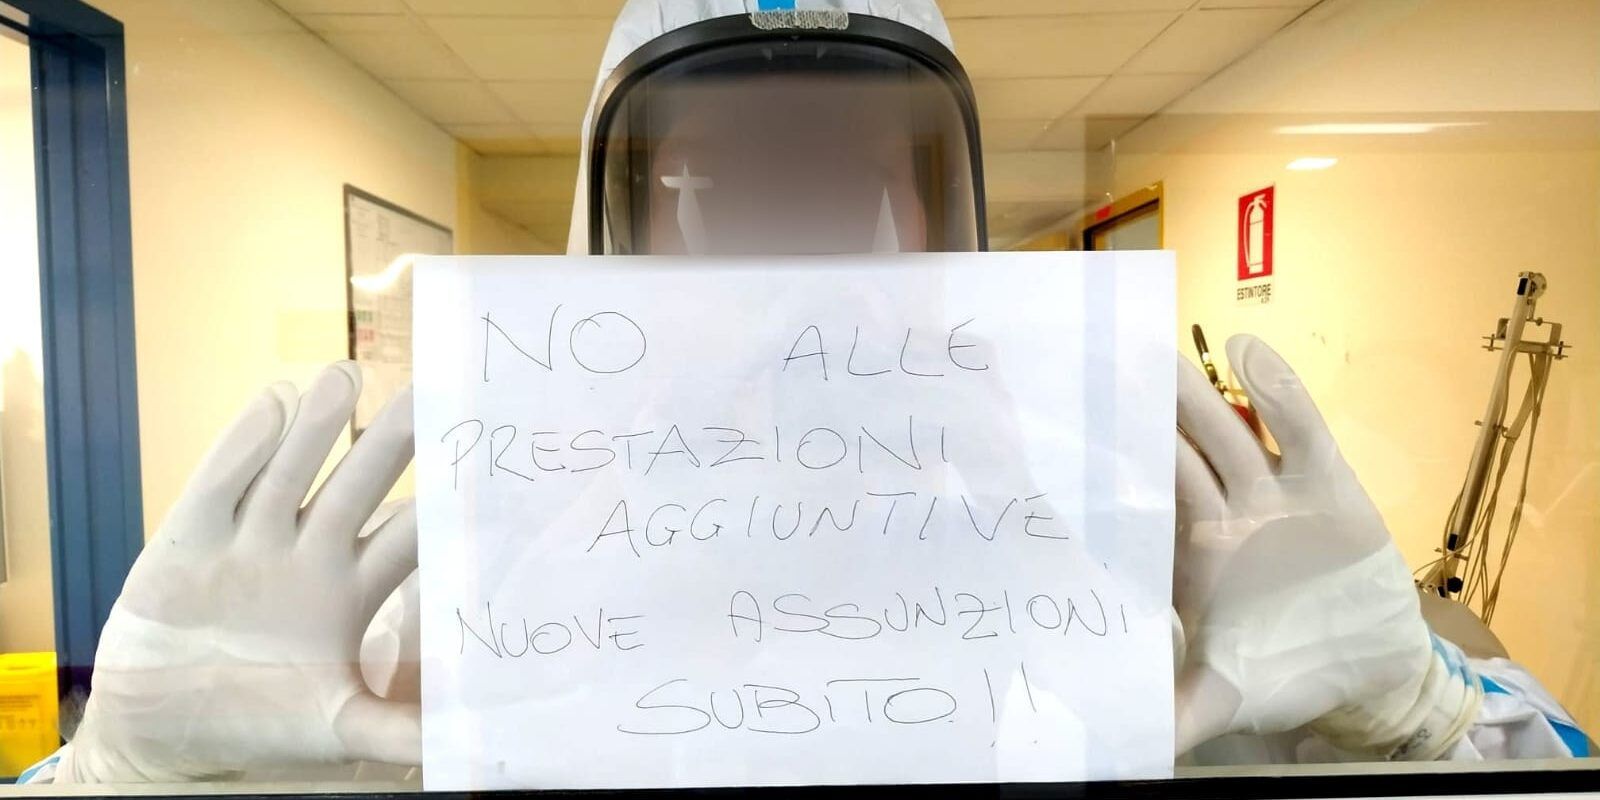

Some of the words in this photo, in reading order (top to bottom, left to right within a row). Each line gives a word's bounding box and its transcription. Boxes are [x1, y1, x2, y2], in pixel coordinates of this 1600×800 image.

[1237, 283, 1271, 300] ESTINTORE
[481, 304, 647, 382] NO
[783, 318, 989, 381] ALLE
[441, 415, 950, 491] PRESTAZIONI
[586, 492, 1070, 558] AGGIUNTIVE
[455, 601, 645, 659] NUOVE
[727, 584, 1128, 642] ASSUNZIONI
